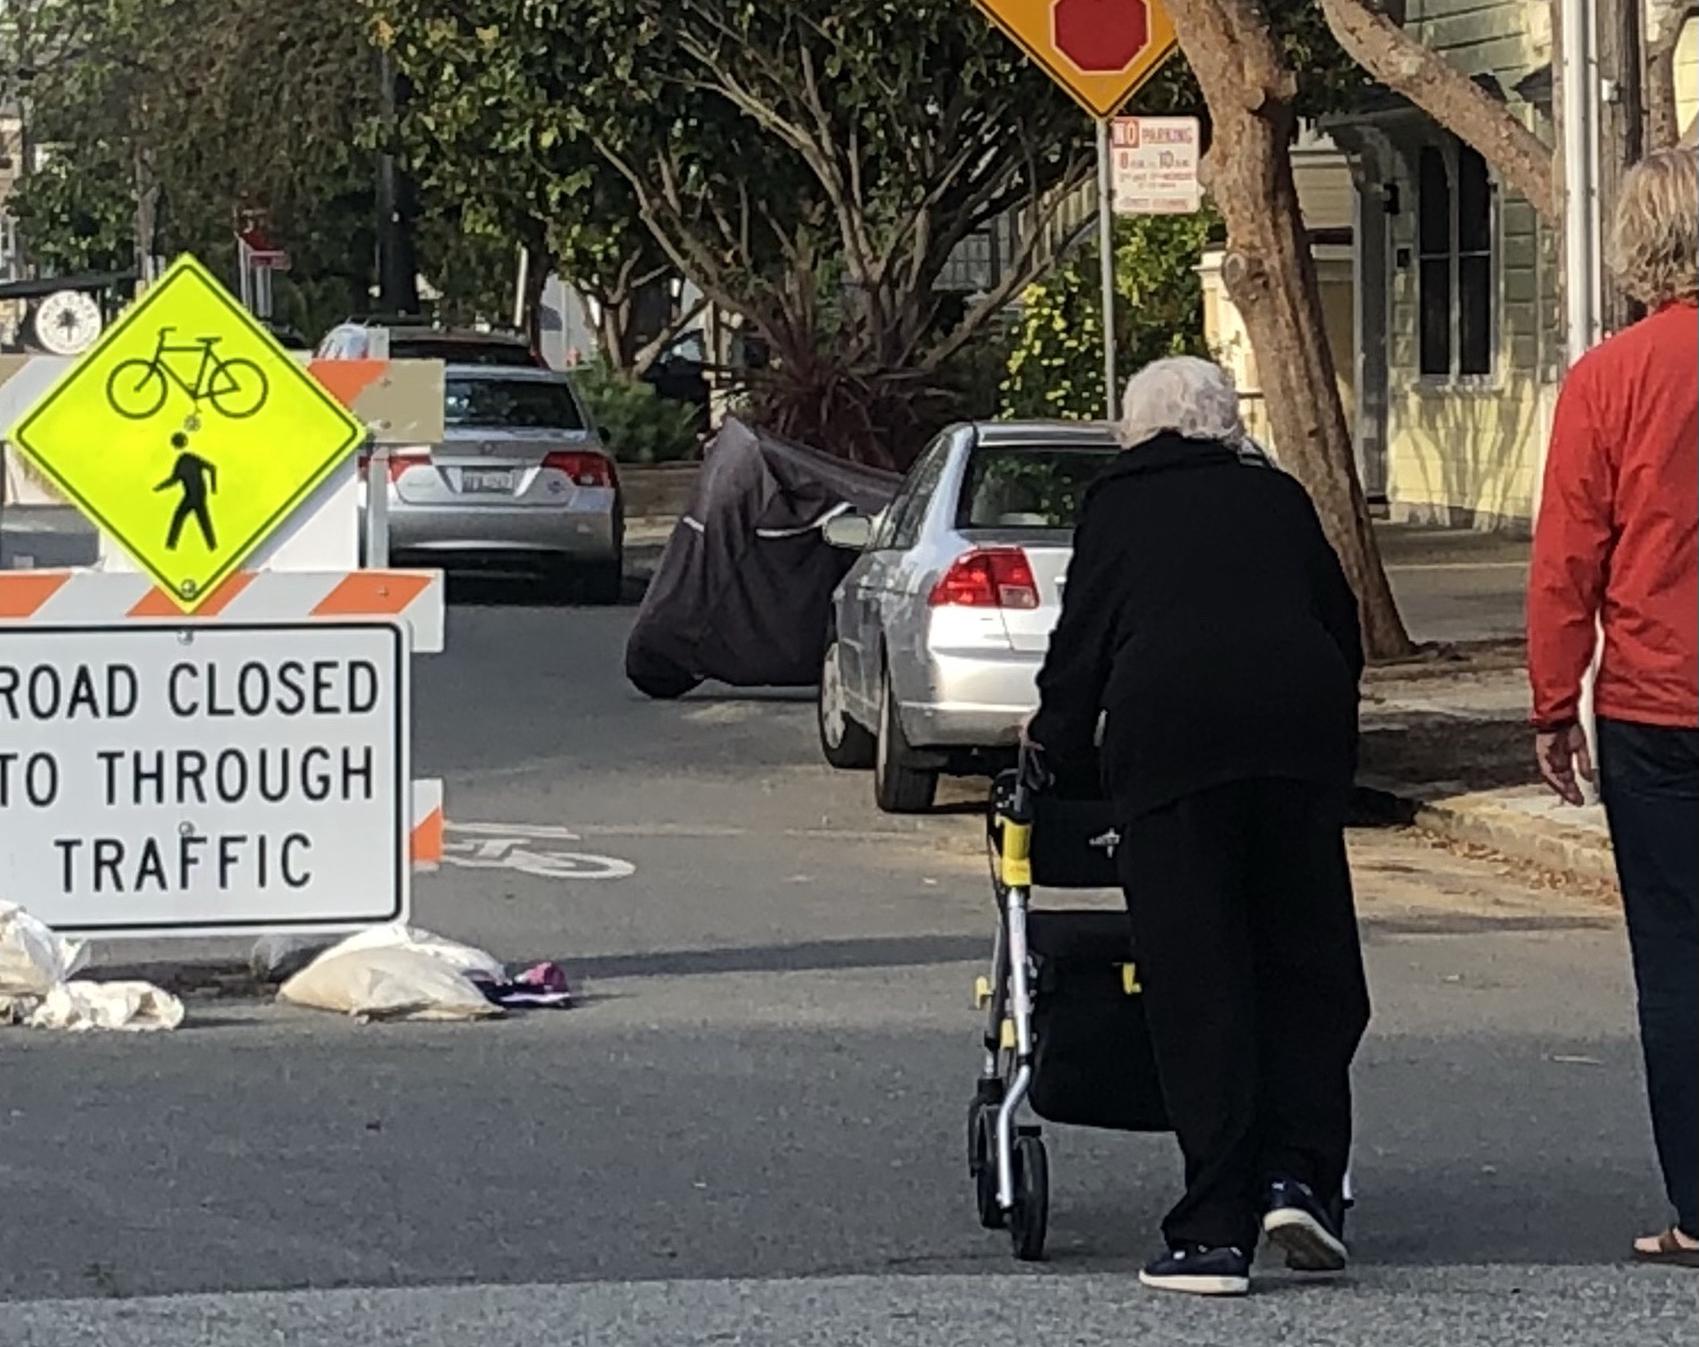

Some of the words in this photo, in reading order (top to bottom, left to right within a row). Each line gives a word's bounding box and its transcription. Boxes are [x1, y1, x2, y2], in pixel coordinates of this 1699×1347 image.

[0, 664, 137, 719] ROAD
[169, 660, 378, 717] CLOSED
[0, 752, 58, 807] TO
[97, 746, 372, 805] THROUGH
[54, 833, 310, 893] TRAFFIC
